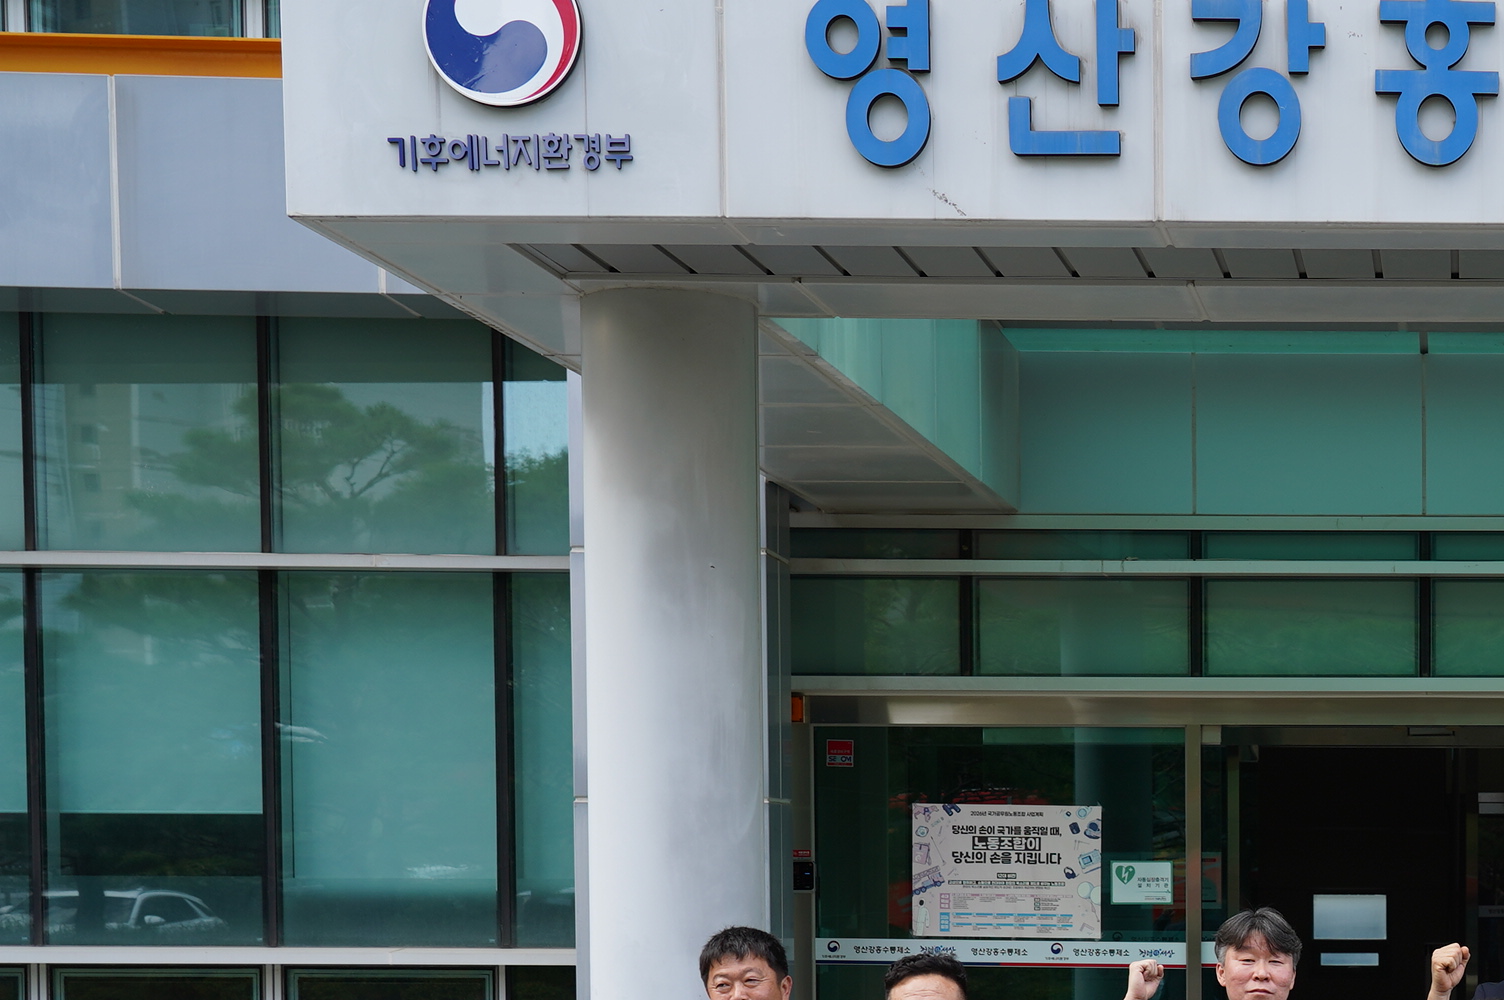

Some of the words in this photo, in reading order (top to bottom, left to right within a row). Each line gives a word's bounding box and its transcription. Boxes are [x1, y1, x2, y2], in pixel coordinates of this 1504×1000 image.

[387, 132, 634, 173] 기후에너지환경부
[951, 825, 977, 836] 당신의
[979, 826, 996, 836] 손이
[997, 826, 1022, 836] 국가를
[1023, 826, 1049, 837] 움직일
[1050, 826, 1062, 838] 때,
[973, 837, 1040, 850] 노동조합이
[951, 852, 986, 865] 당신의
[990, 852, 1012, 865] 손을
[1015, 852, 1062, 865] 지킵니다
[853, 945, 911, 955] 영산강홍수통제소
[970, 947, 1028, 956] 영산강홍수통제소
[1072, 948, 1130, 957] 영산강홍수통제소
